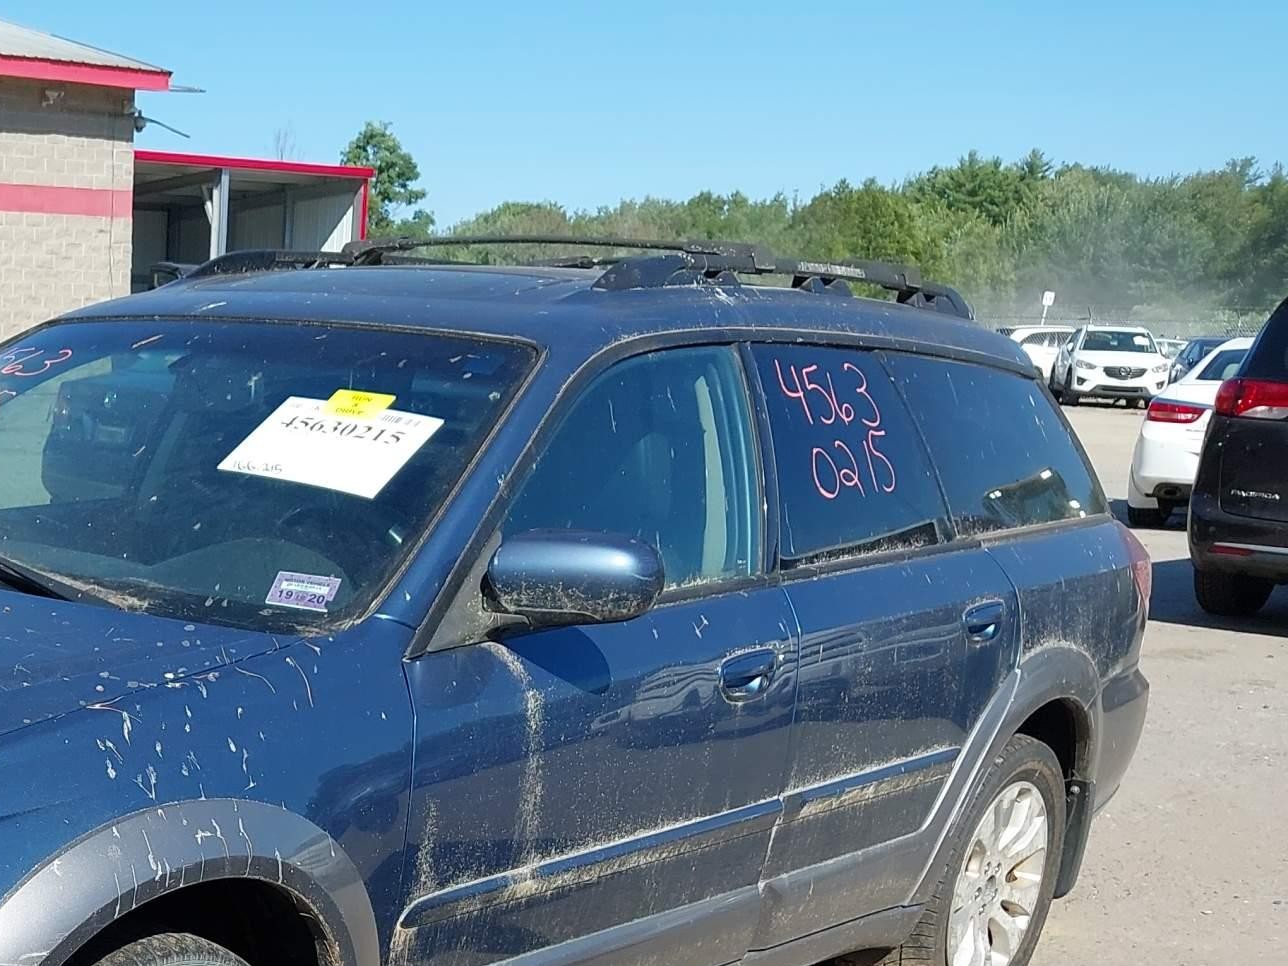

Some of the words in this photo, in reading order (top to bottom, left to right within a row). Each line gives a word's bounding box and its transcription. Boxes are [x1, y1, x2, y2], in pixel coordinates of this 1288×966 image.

[774, 358, 881, 427] 4563
[281, 415, 407, 445] 45630215
[812, 430, 896, 499] 0215
[278, 589, 294, 600] 19
[307, 593, 325, 604] 20
